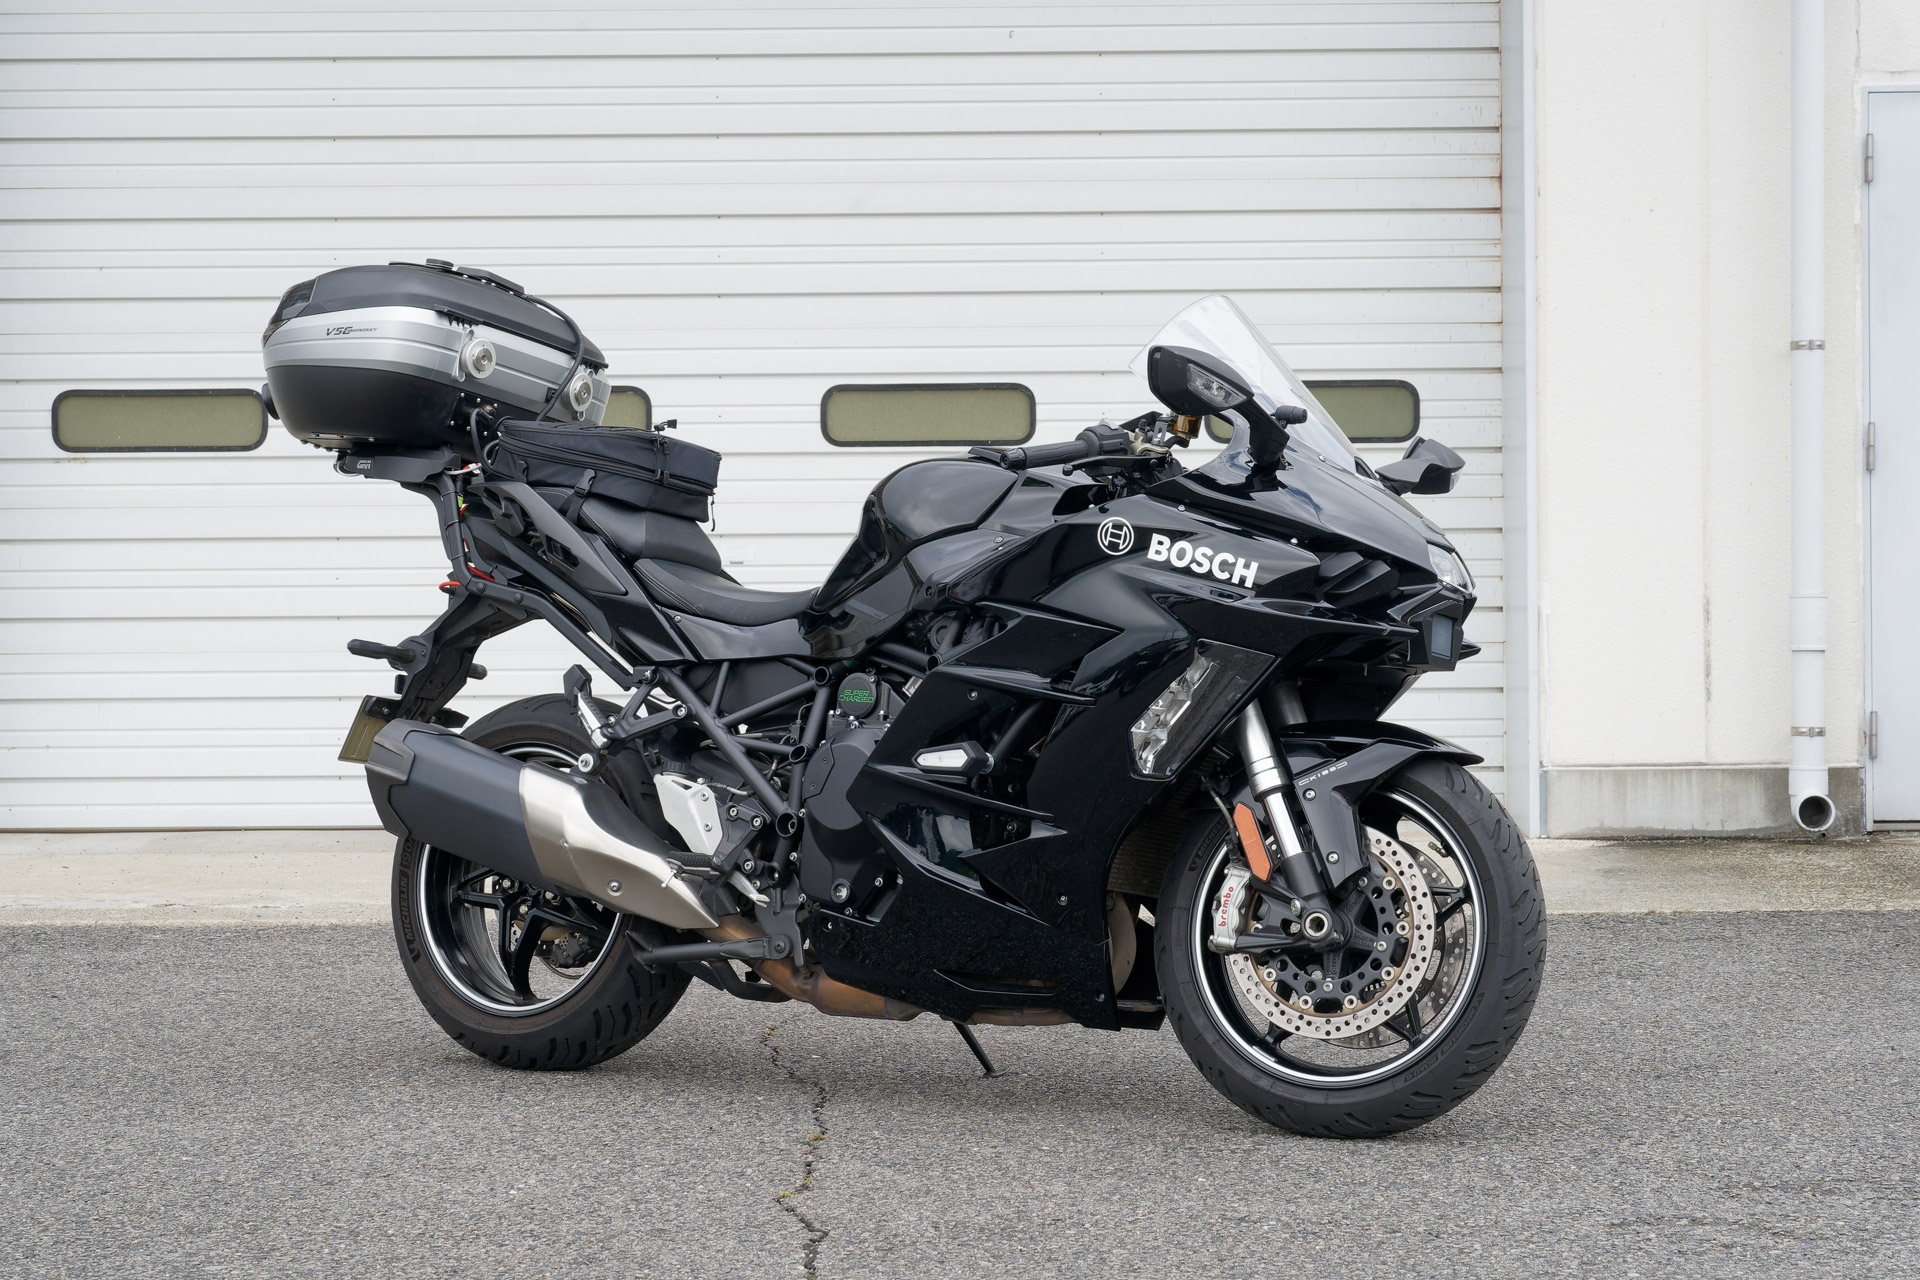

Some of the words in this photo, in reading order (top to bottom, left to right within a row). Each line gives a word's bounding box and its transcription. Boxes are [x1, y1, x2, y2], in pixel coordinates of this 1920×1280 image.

[1147, 532, 1259, 588] BOSCH
[838, 695, 875, 703] CHARGED
[843, 689, 869, 697] SUPER
[400, 877, 414, 940] MICHELIN
[1218, 886, 1234, 927] brembo
